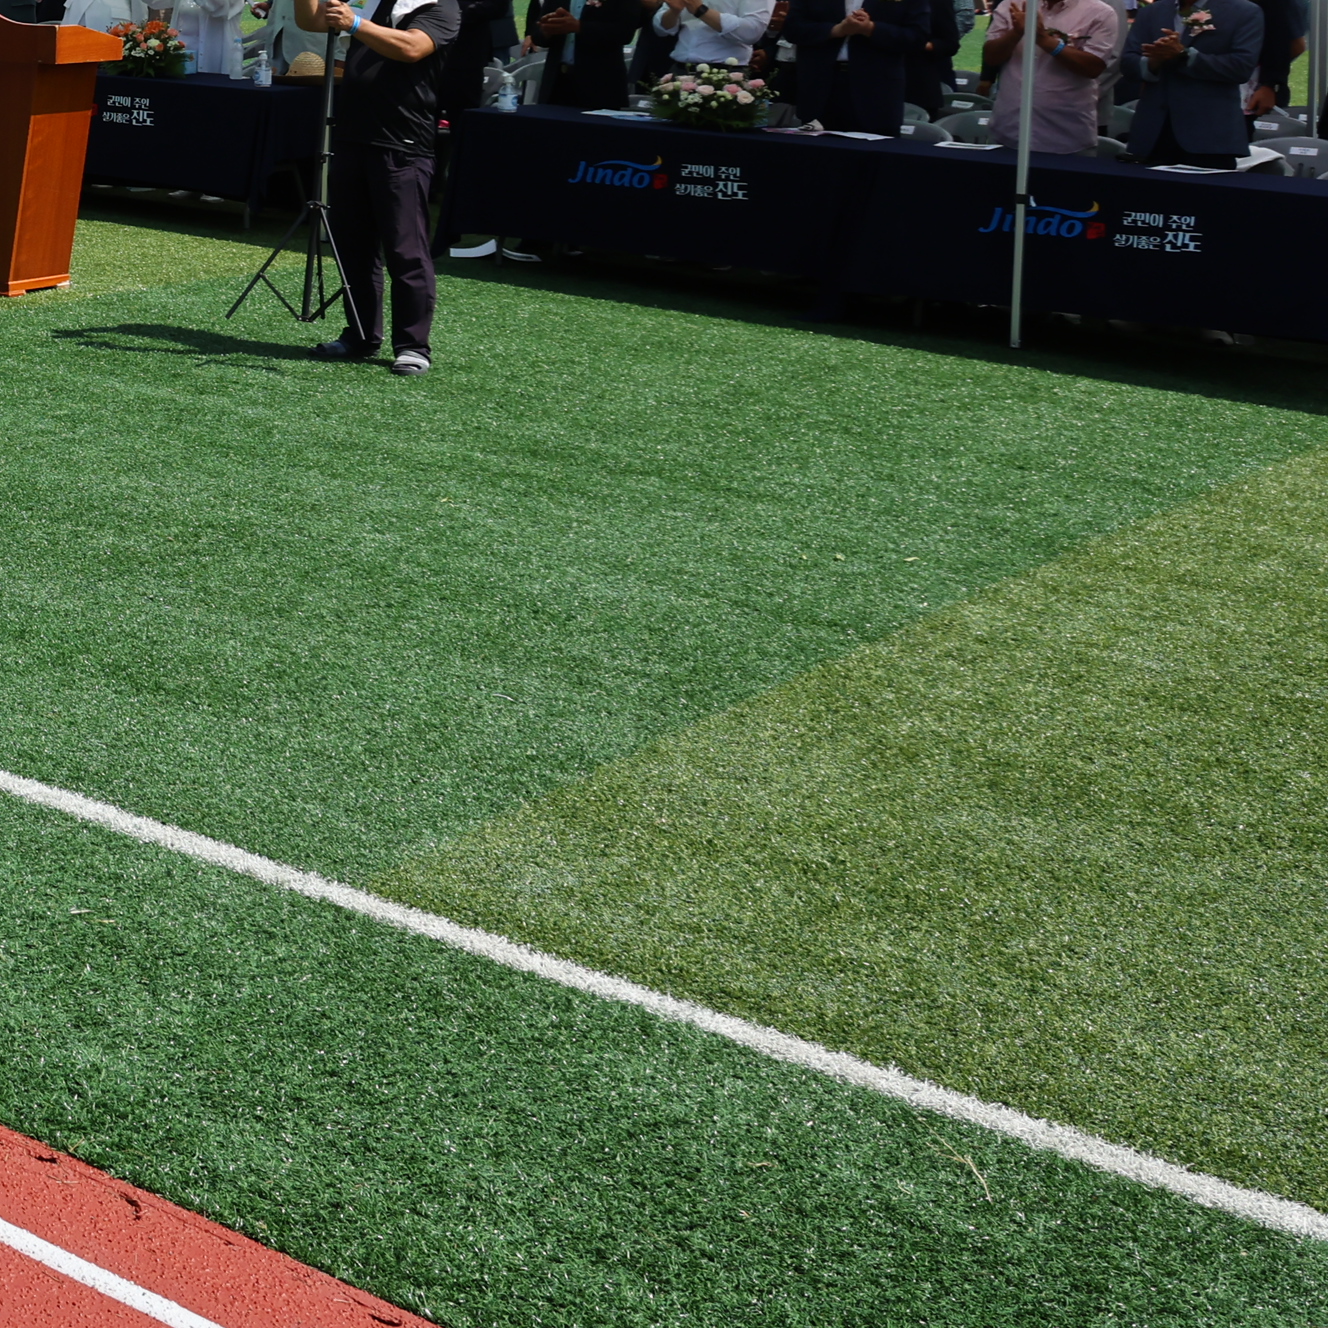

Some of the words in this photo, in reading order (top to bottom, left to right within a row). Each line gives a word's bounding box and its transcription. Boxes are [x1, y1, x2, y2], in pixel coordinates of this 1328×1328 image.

[107, 94, 131, 108] 군민이
[133, 97, 150, 110] 주인
[131, 109, 155, 127] 진도
[567, 160, 651, 189] Jindo
[680, 163, 714, 179] 군민이
[717, 166, 741, 180] 주인
[714, 180, 749, 200] 진도
[1122, 211, 1164, 228] 군민이
[1167, 214, 1196, 231] 주인
[1162, 231, 1203, 253] 진도
